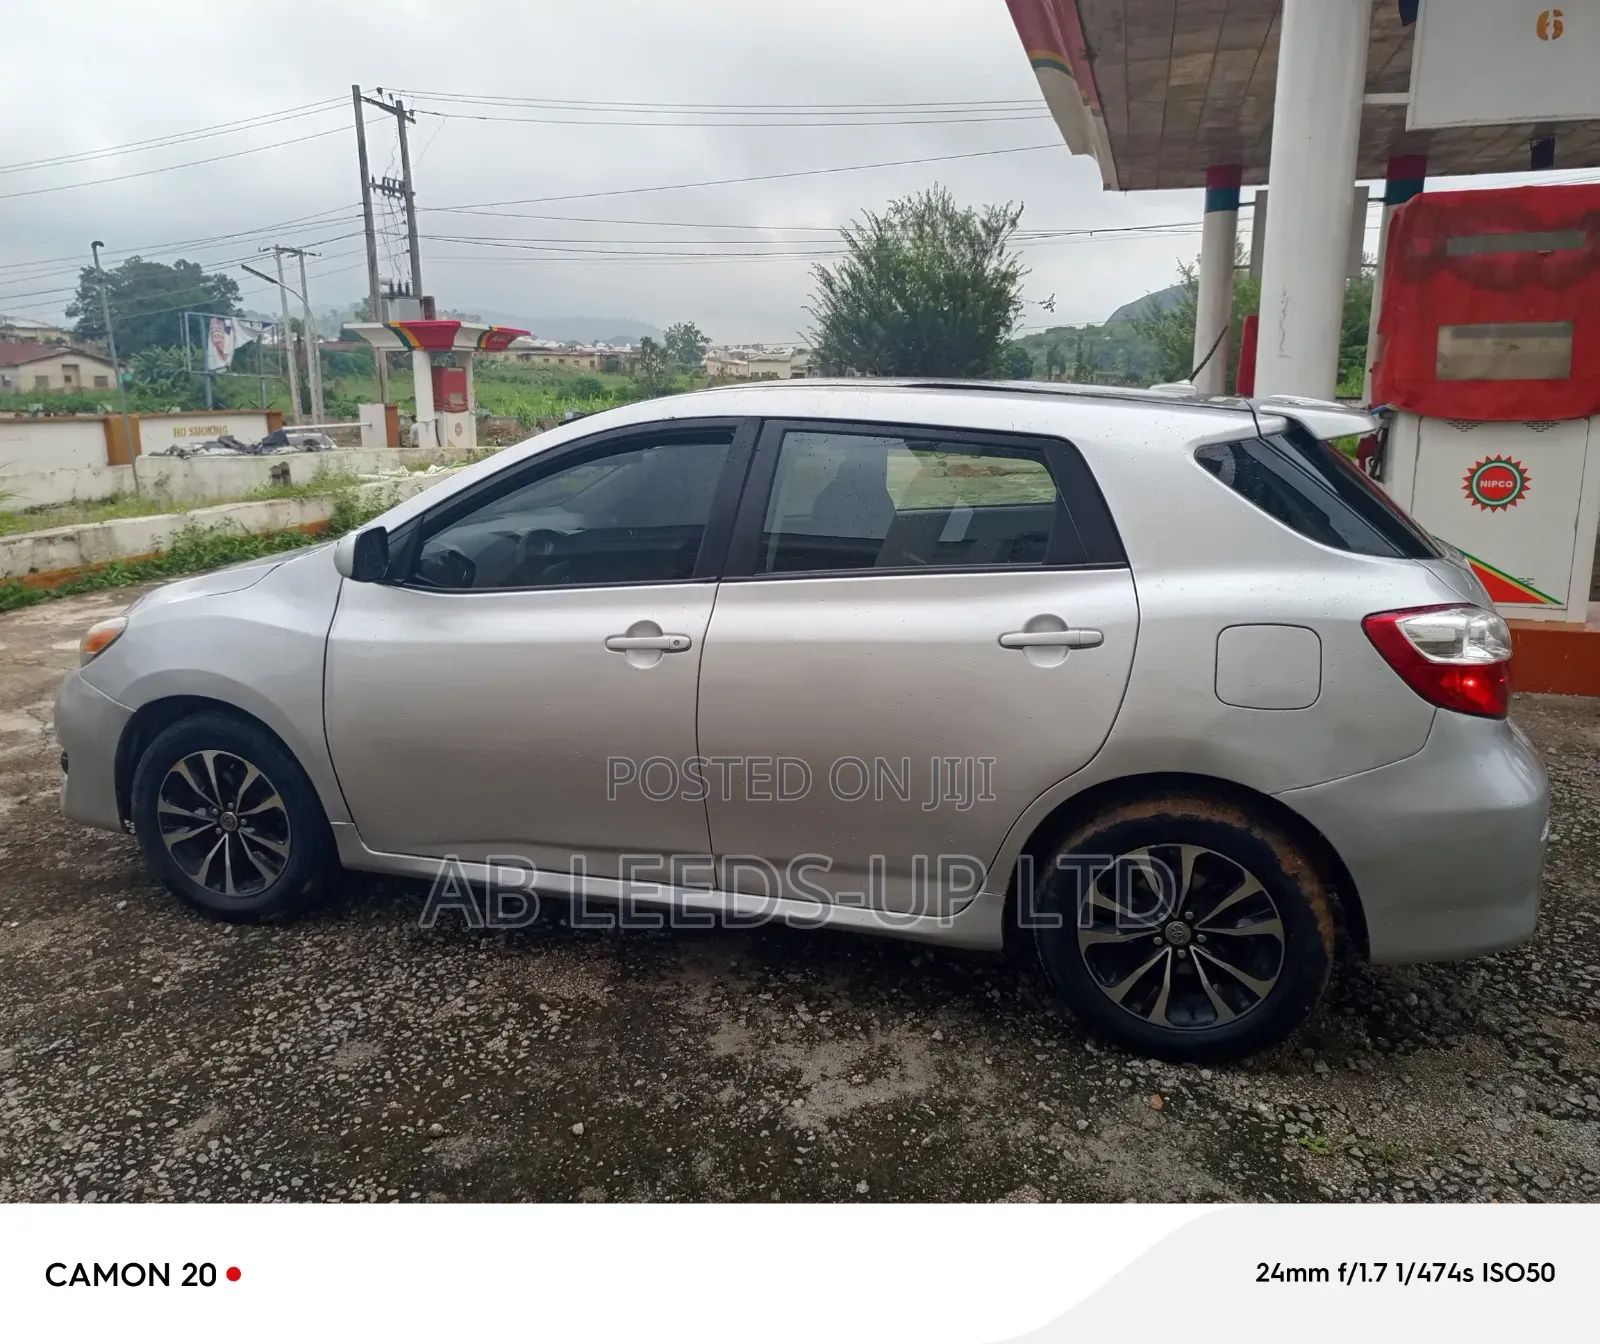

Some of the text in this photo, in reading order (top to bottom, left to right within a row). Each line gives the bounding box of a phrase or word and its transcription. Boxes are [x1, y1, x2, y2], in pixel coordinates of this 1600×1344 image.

[1536, 8, 1564, 41] 6
[173, 425, 228, 438] NO SMOKING
[1480, 480, 1513, 488] NIPCO
